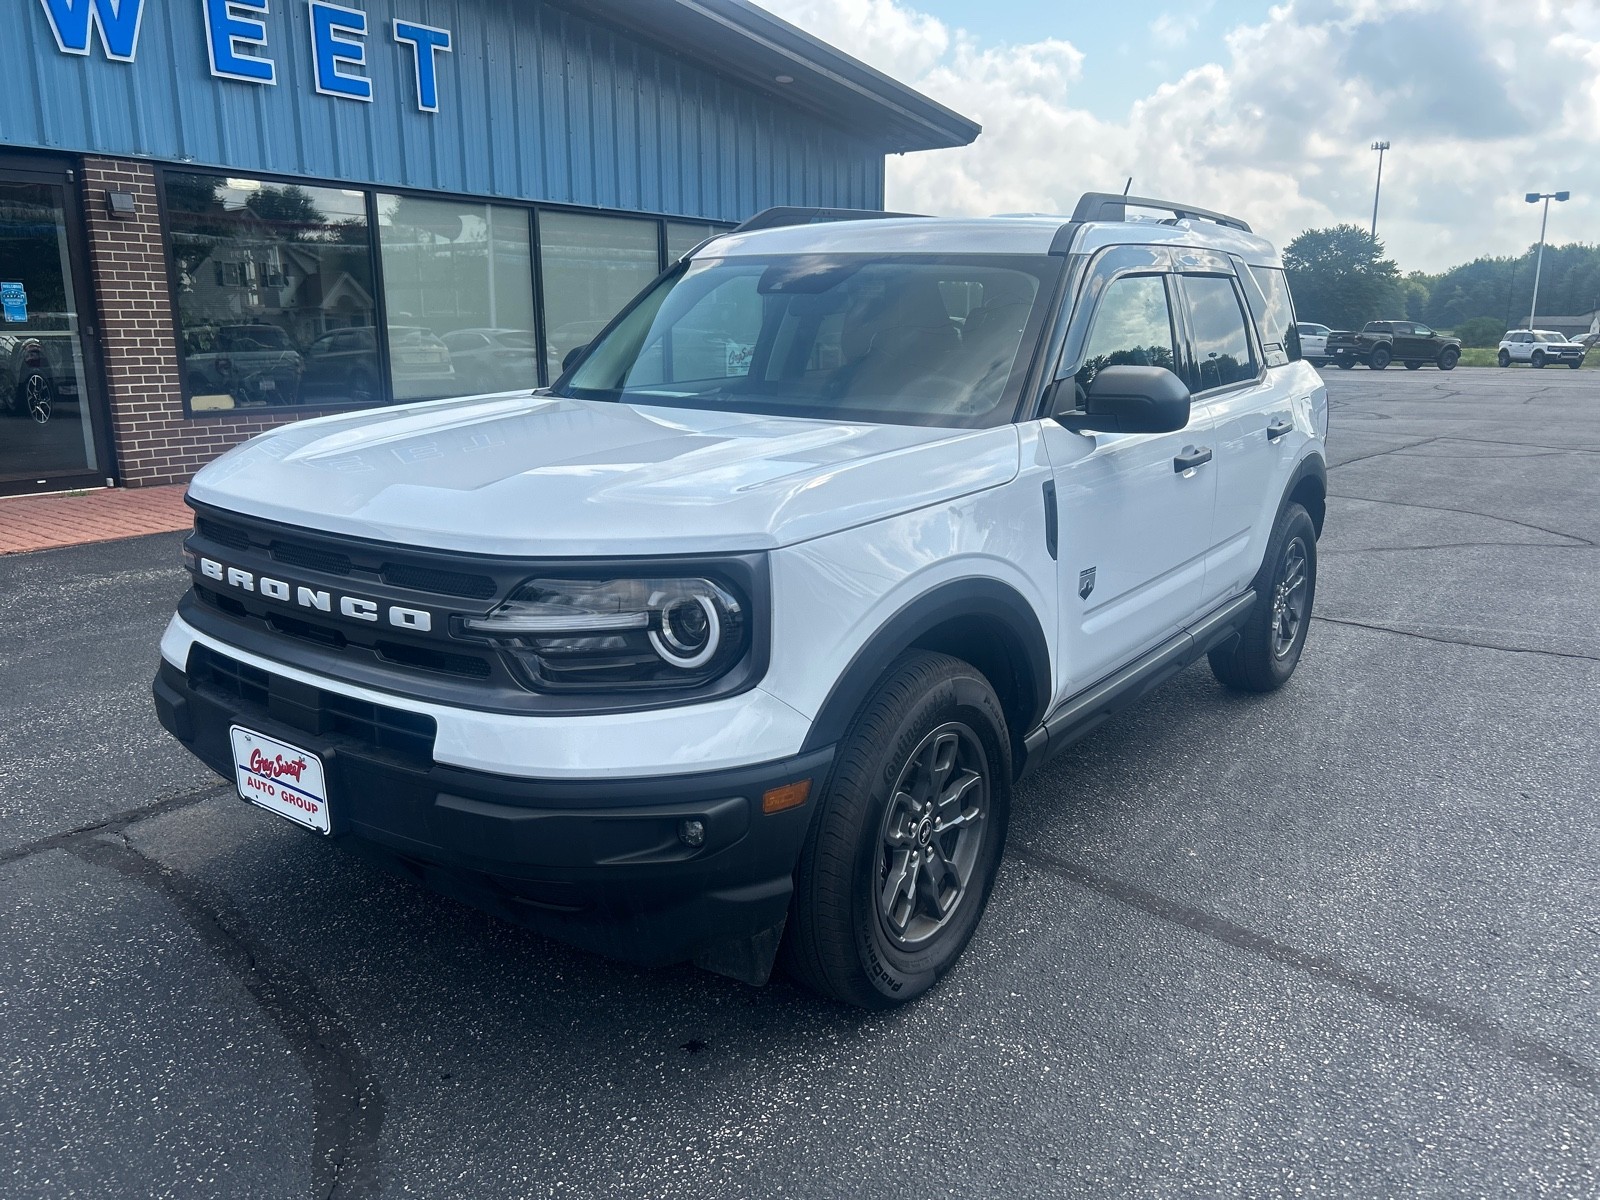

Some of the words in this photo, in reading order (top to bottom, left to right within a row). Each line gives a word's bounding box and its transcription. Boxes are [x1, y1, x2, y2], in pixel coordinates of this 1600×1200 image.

[201, 557, 432, 632] BRONCO
[250, 748, 274, 779] Greg
[247, 776, 275, 796] AUTO
[281, 790, 318, 814] GROUP
